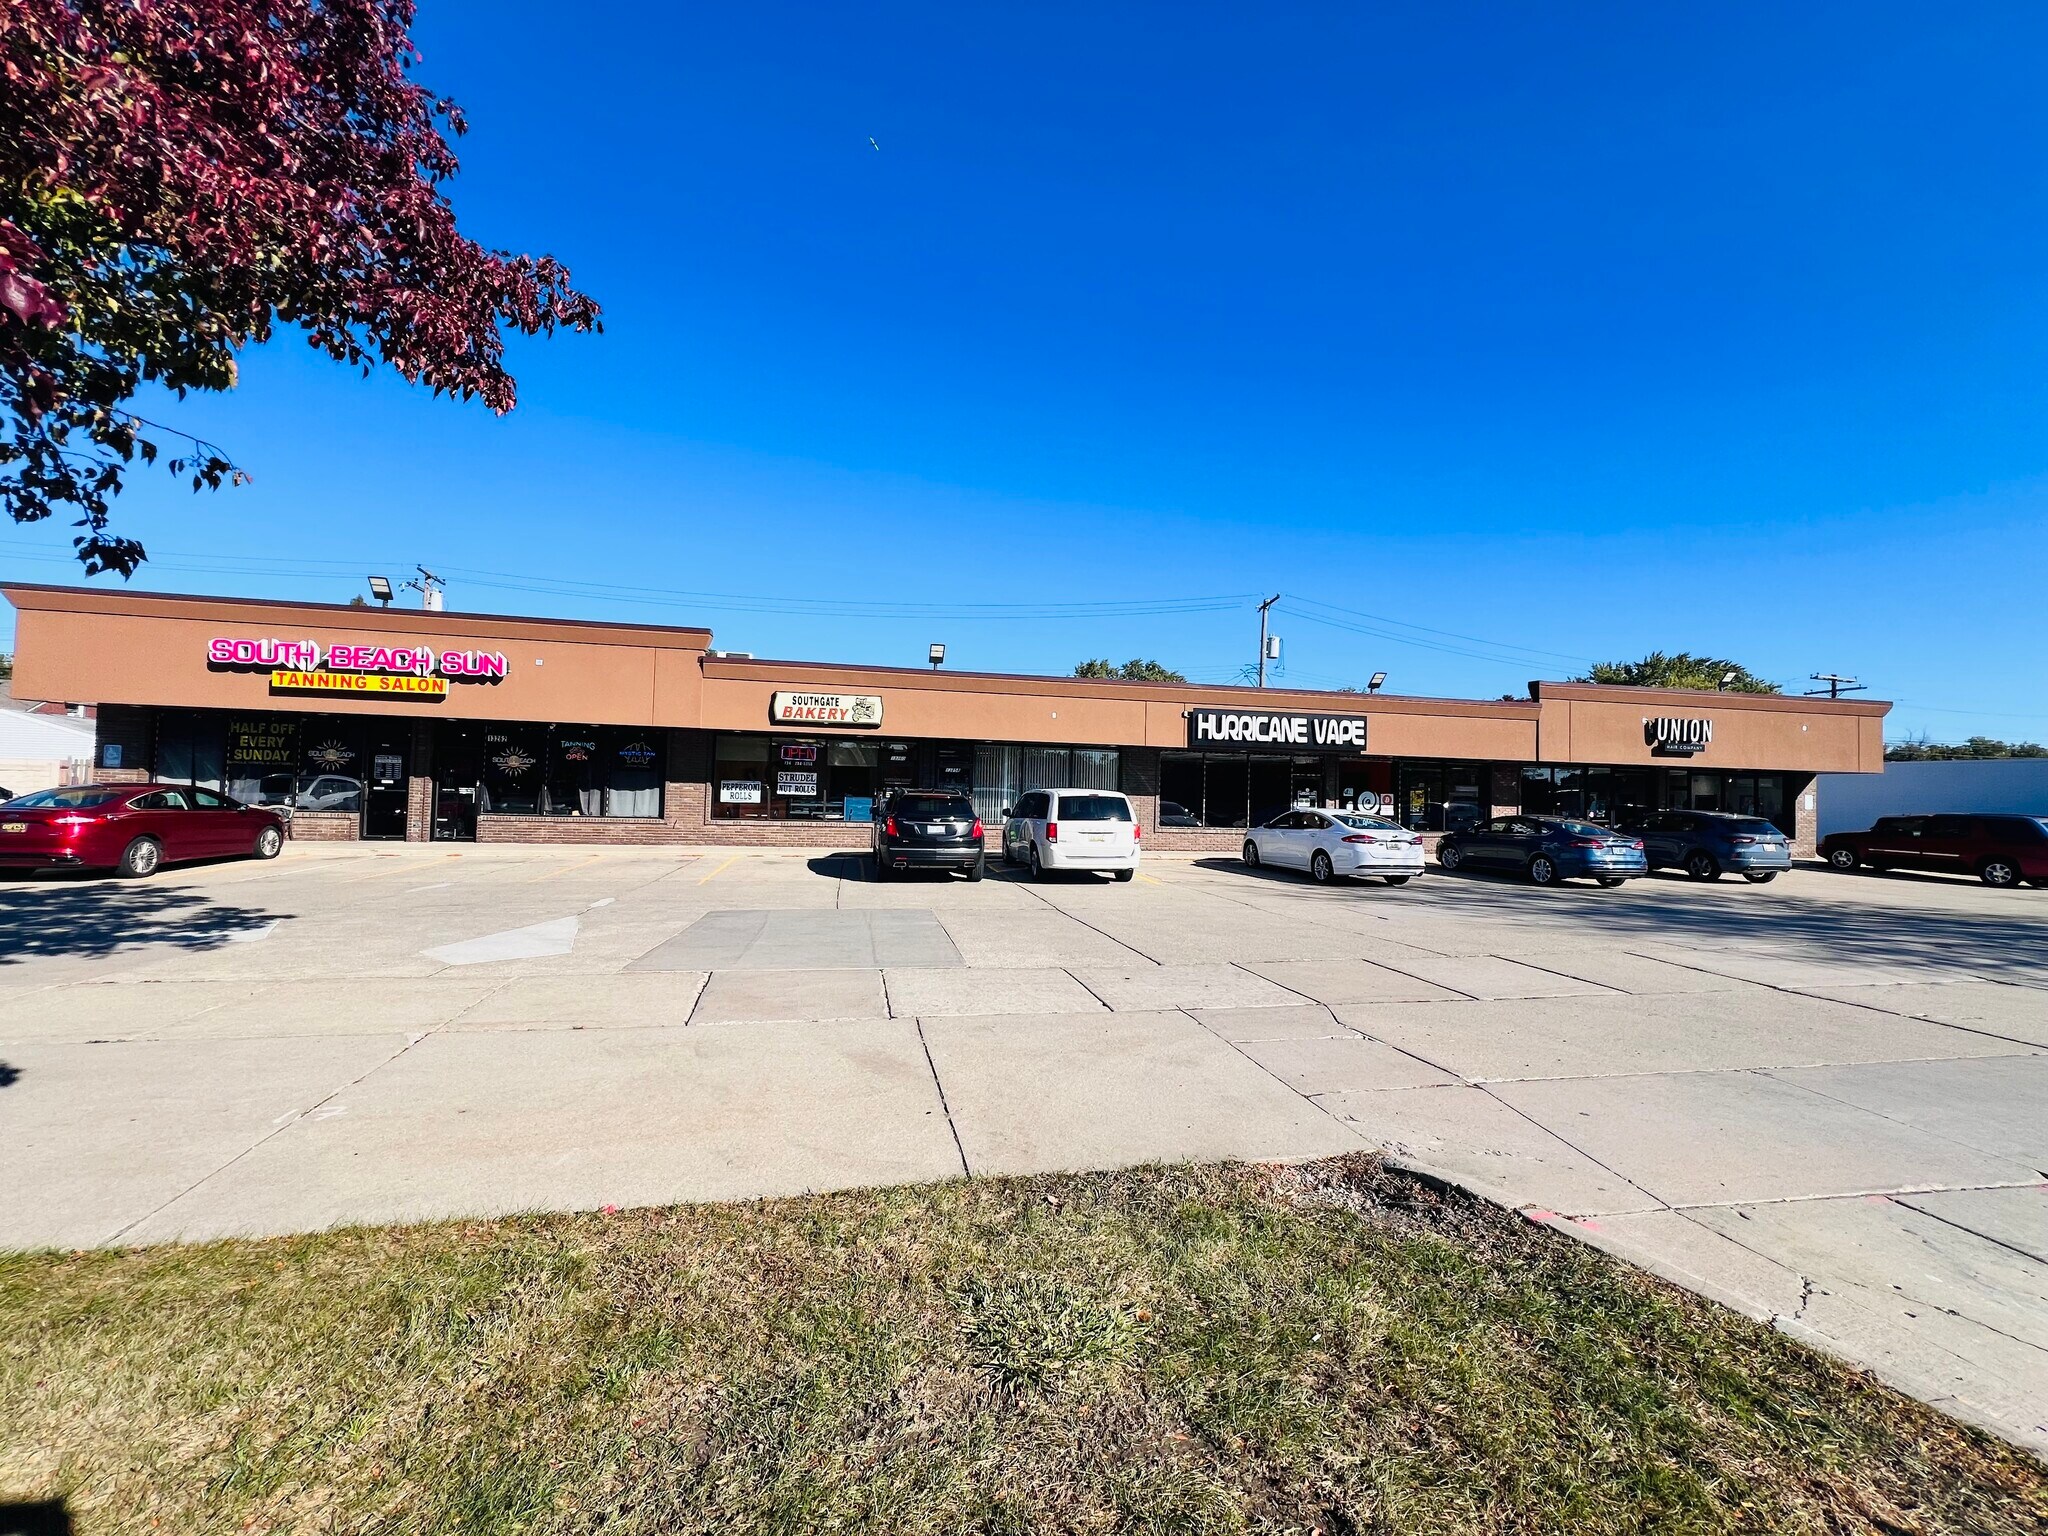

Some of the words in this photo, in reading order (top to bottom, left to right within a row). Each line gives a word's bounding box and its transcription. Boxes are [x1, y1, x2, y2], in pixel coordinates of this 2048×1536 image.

[208, 638, 320, 671] SOUTH
[328, 645, 435, 677] BEACH
[441, 650, 509, 677] SUN
[276, 672, 367, 690] TANNING
[380, 677, 443, 692] SALON
[792, 695, 839, 707] SOUTHGATE
[782, 706, 849, 720] BAKERY
[231, 722, 266, 733] HALF
[270, 723, 295, 735] OFF
[1197, 713, 1308, 743] HURRICANE
[1314, 718, 1365, 746] VAPE
[1657, 717, 1712, 742] UNION
[240, 735, 285, 748] EVERY
[561, 741, 596, 751] TANNING
[234, 749, 290, 761] SUNDAY
[565, 753, 588, 761] OPEN
[784, 747, 815, 760] OPEN
[779, 773, 815, 782] STRUDEL
[721, 782, 760, 791] PEPPERONI
[779, 784, 793, 792] NUT
[794, 785, 815, 793] ROLLS
[729, 791, 752, 800] ROLLS
